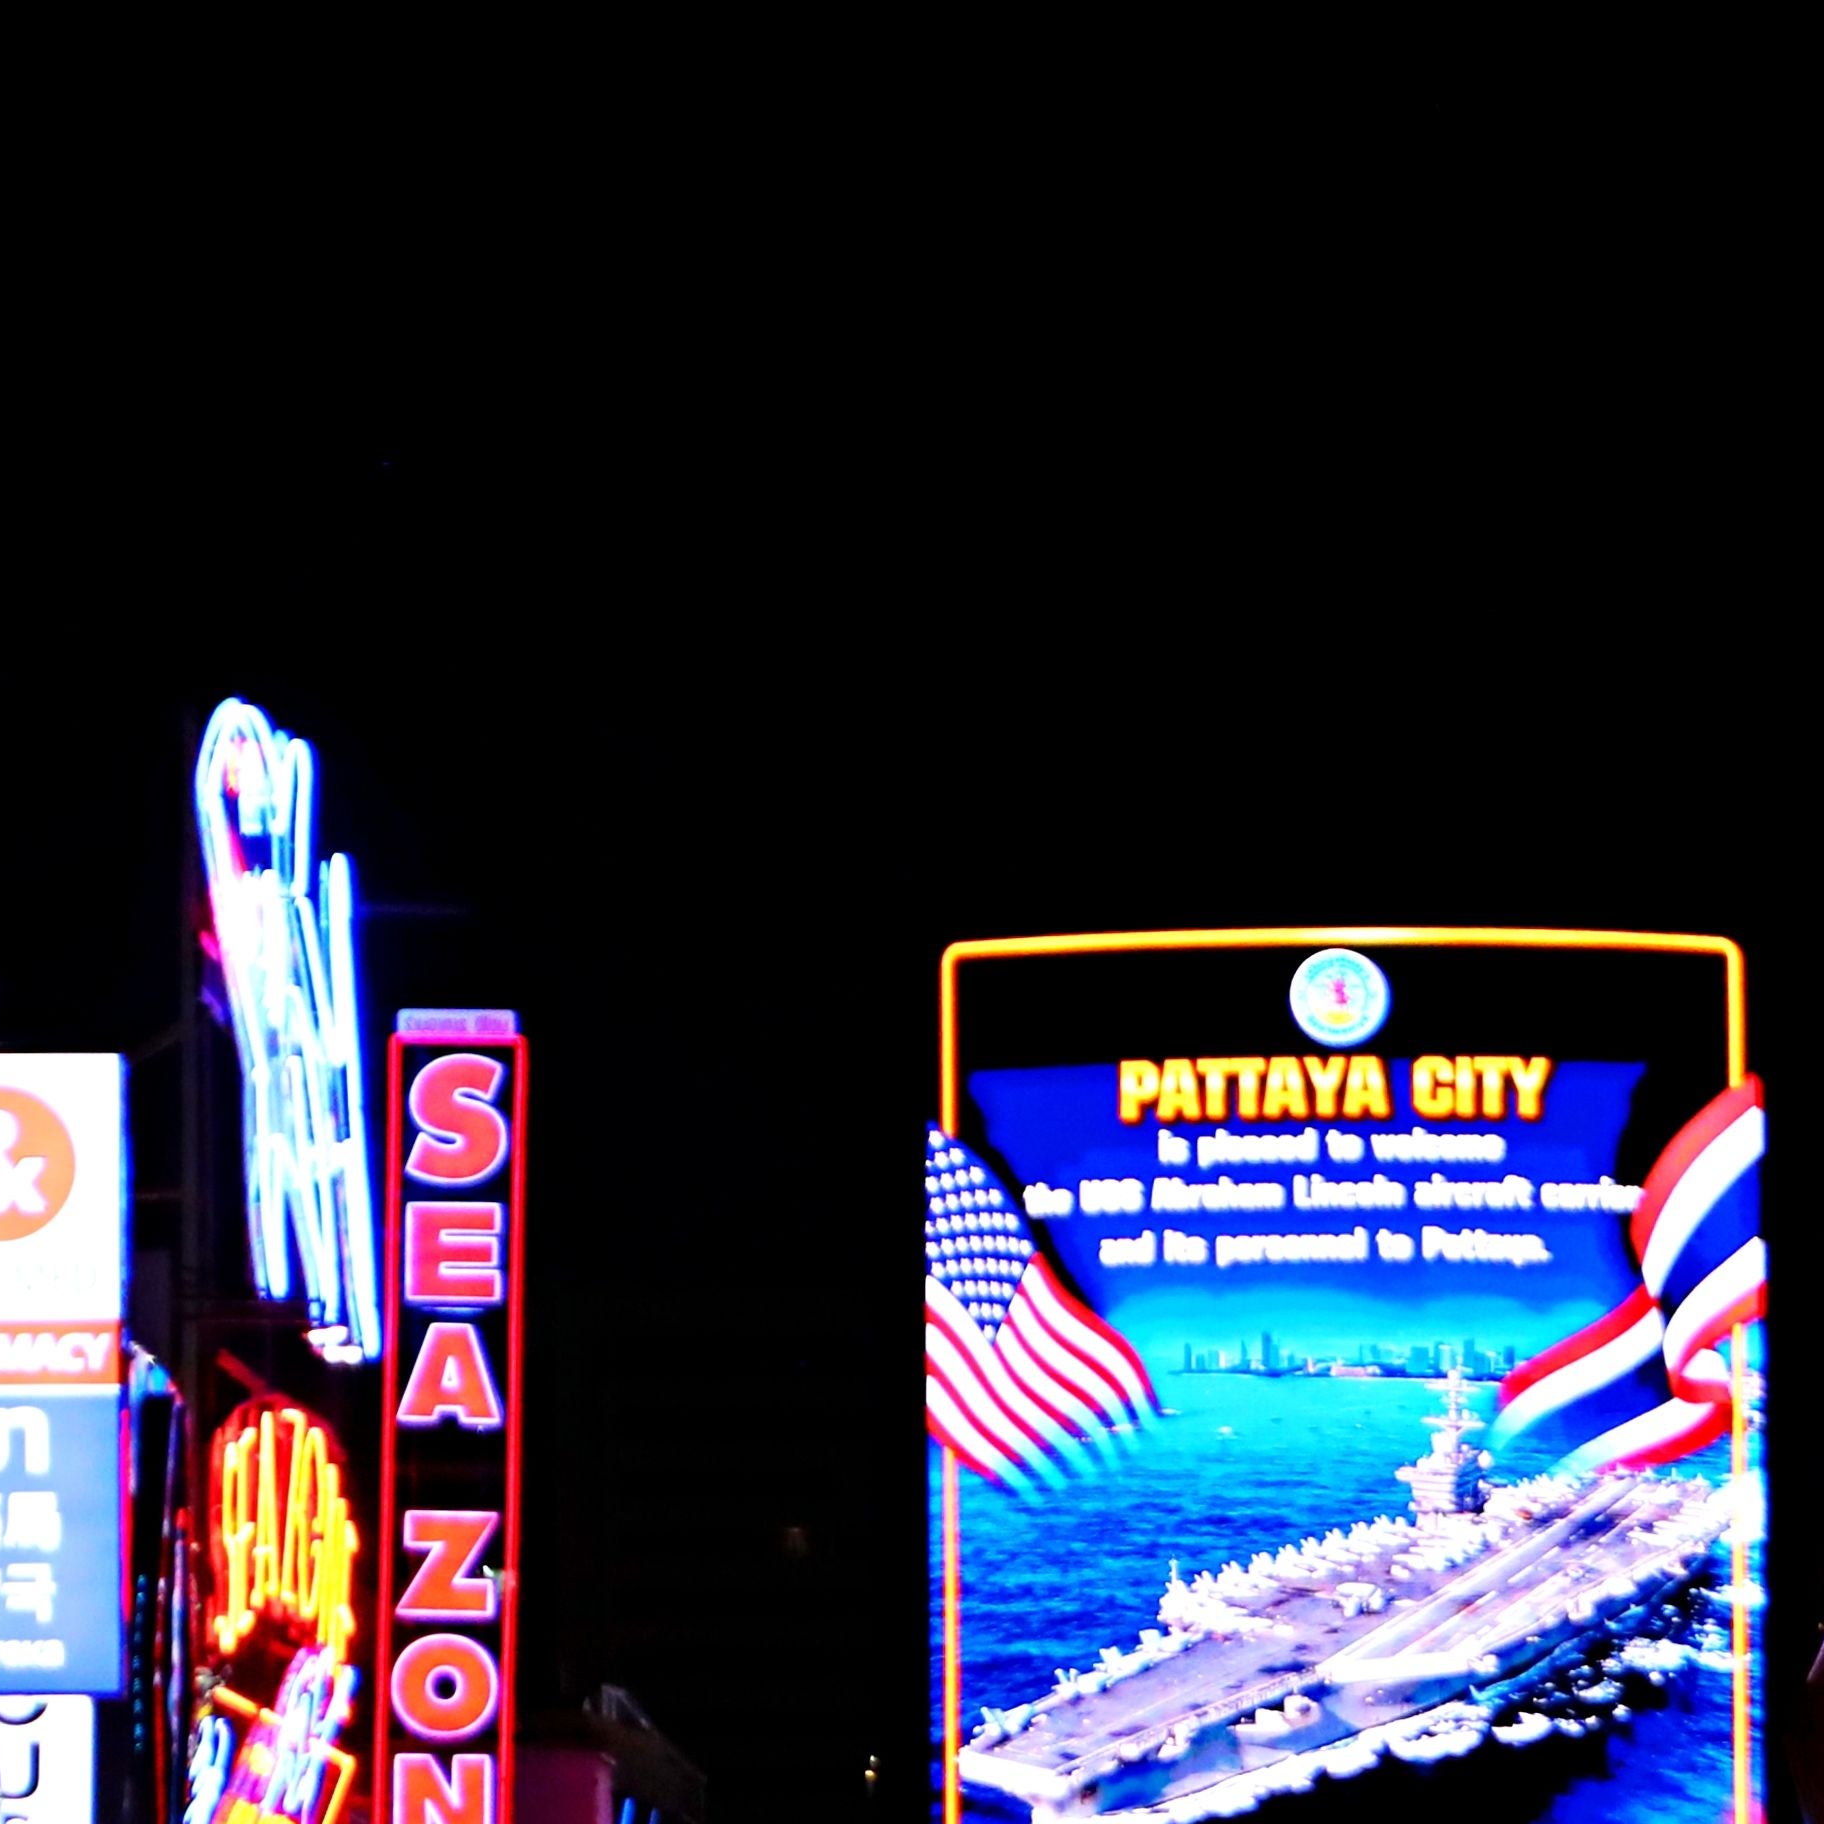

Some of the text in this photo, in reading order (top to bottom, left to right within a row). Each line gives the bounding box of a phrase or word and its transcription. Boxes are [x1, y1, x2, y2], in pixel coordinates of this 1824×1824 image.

[1119, 1054, 1551, 1123] PATTAYA CITY
[396, 1052, 509, 1430] SEA
